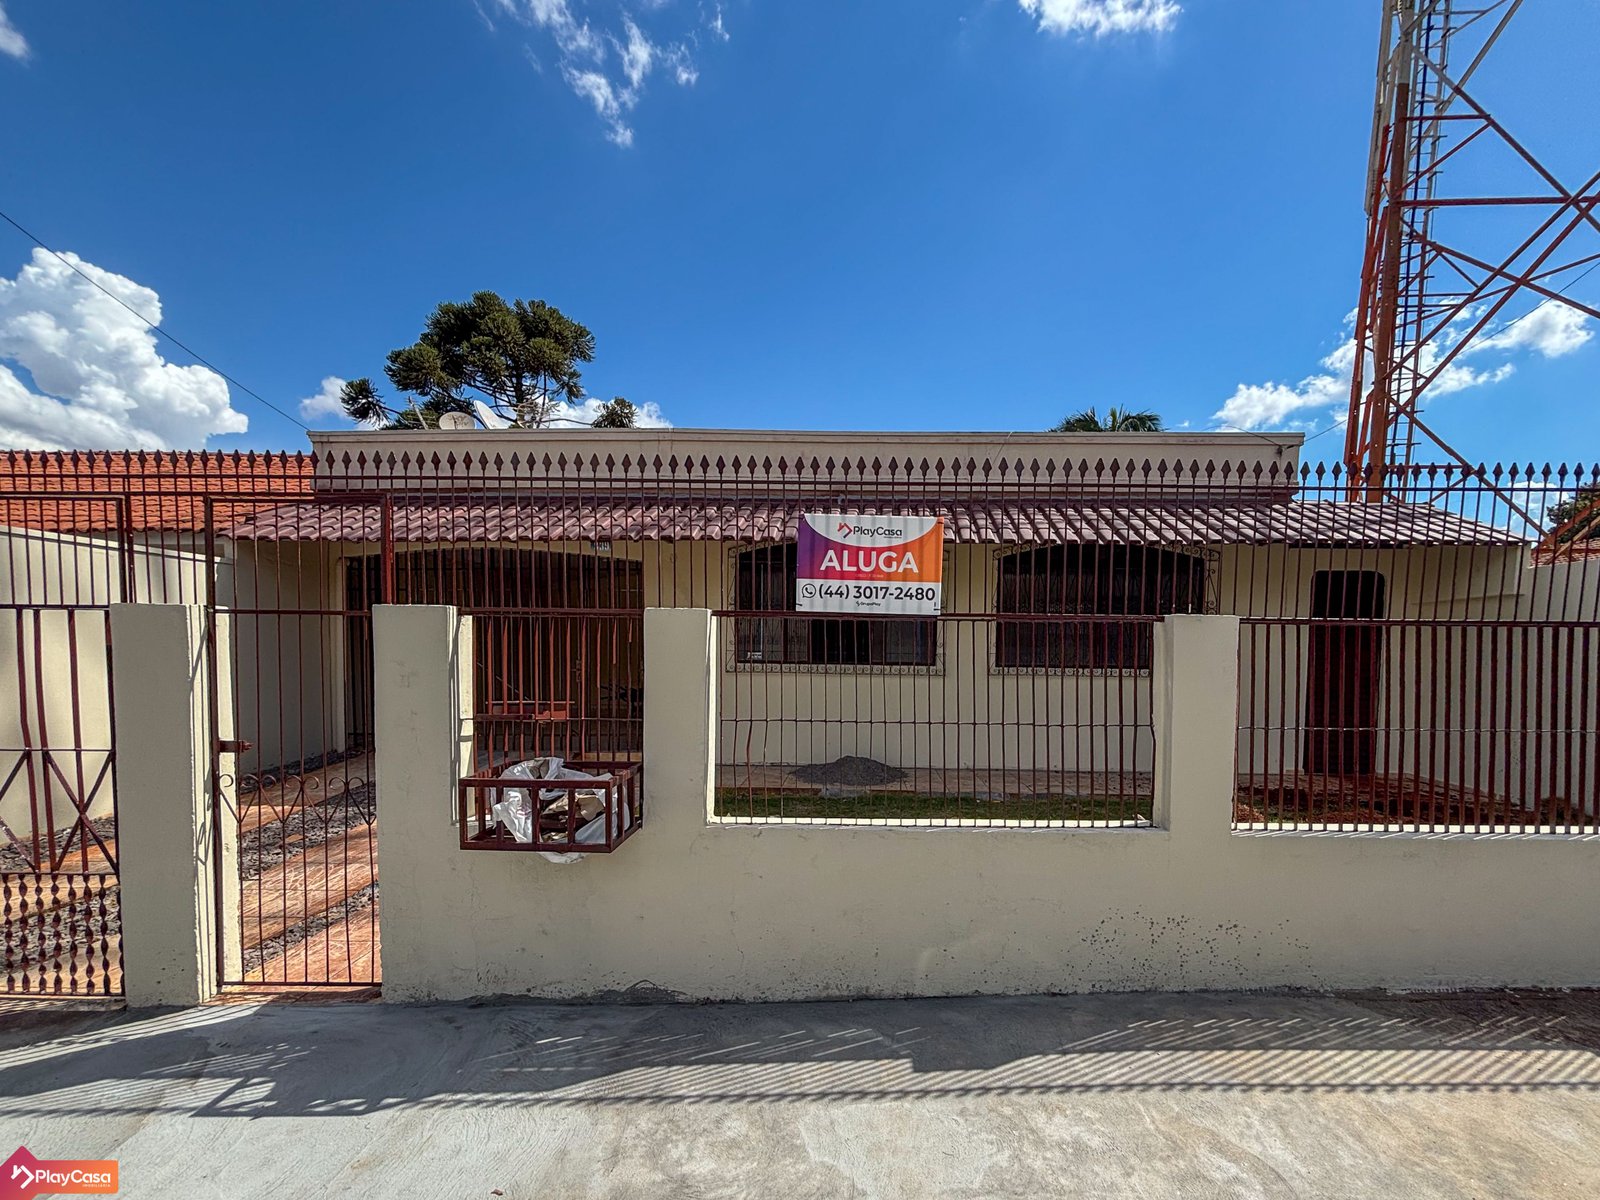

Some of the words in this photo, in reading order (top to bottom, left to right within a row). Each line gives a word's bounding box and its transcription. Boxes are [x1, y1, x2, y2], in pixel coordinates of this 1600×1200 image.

[853, 525, 902, 538] PlayCasa
[819, 549, 919, 574] ALUGA
[818, 583, 850, 600] (44)
[853, 585, 936, 601] 3017-2480
